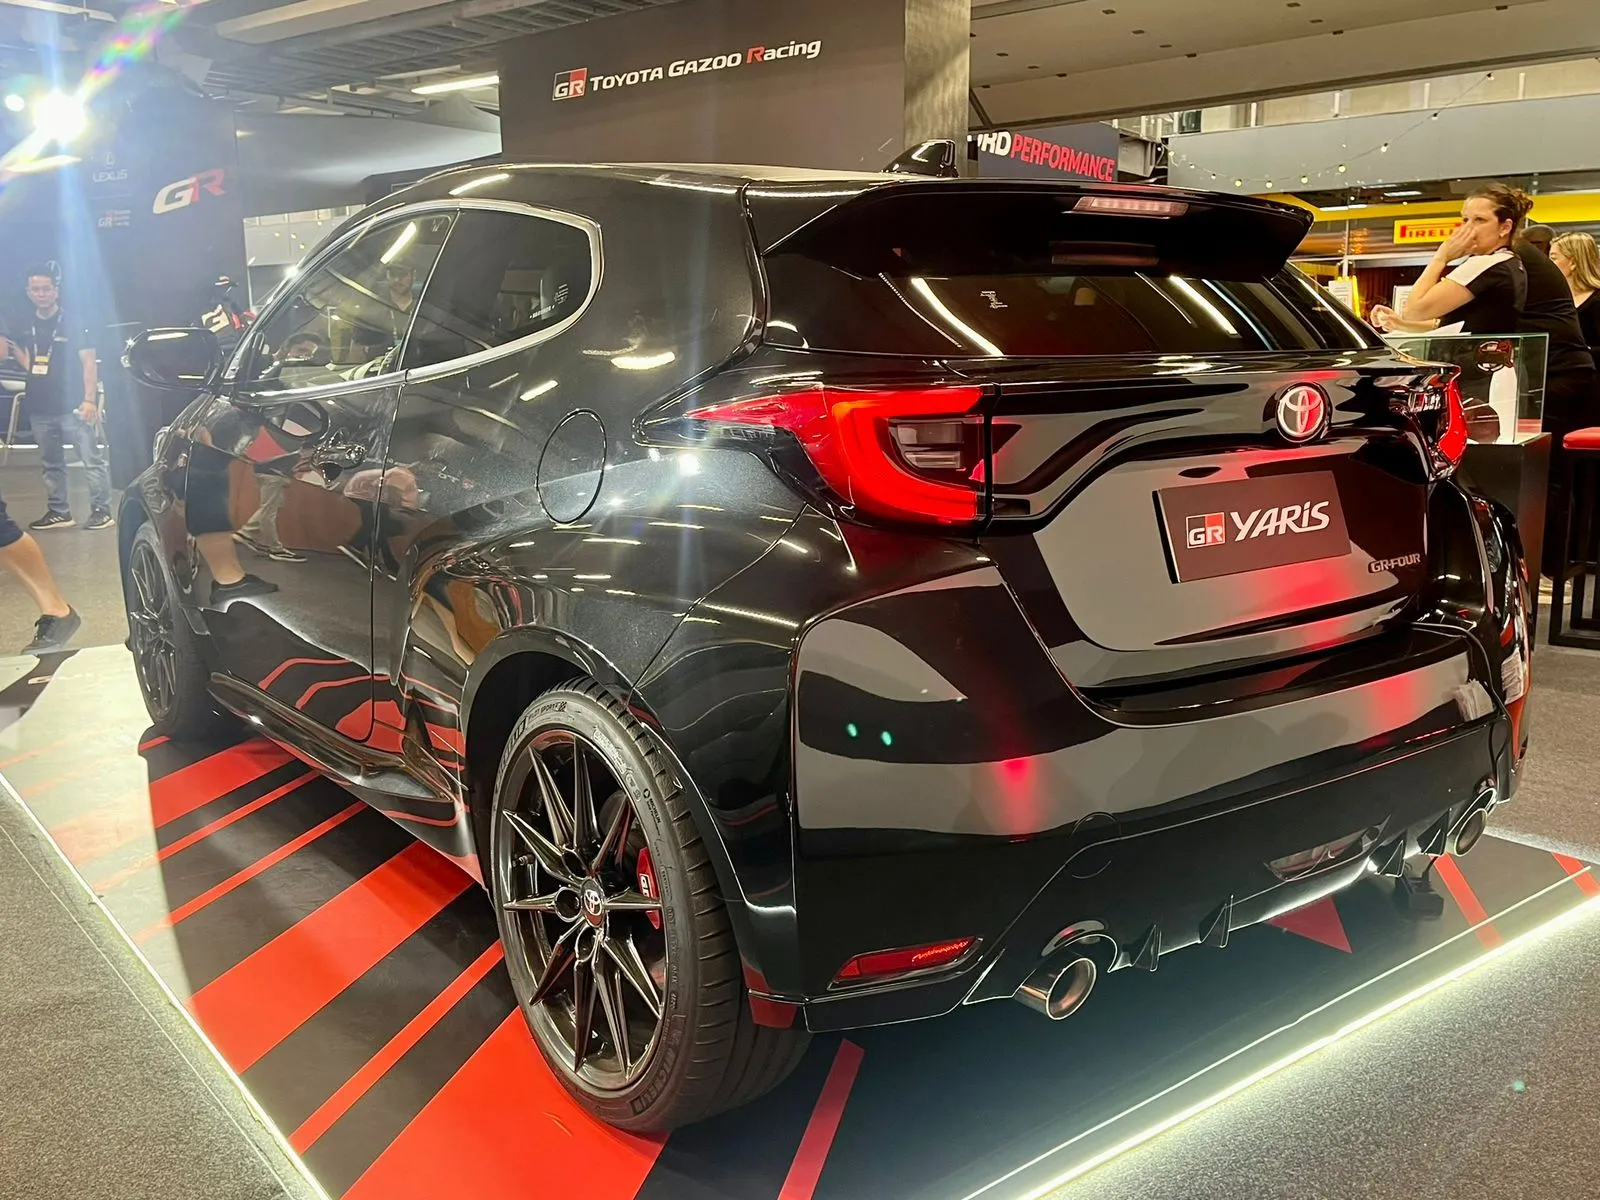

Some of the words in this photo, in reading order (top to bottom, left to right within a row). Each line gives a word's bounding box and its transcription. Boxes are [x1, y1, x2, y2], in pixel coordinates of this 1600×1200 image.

[554, 79, 586, 97] GR
[590, 66, 664, 92] TOYOTA
[668, 52, 742, 78] GAZOO
[746, 40, 822, 64] Racing
[1011, 133, 1116, 182] PERFORMANCE
[92, 169, 128, 182] LEXUS
[152, 168, 226, 214] GR
[1188, 525, 1224, 546] GR
[1370, 553, 1421, 573] GR-FOUR
